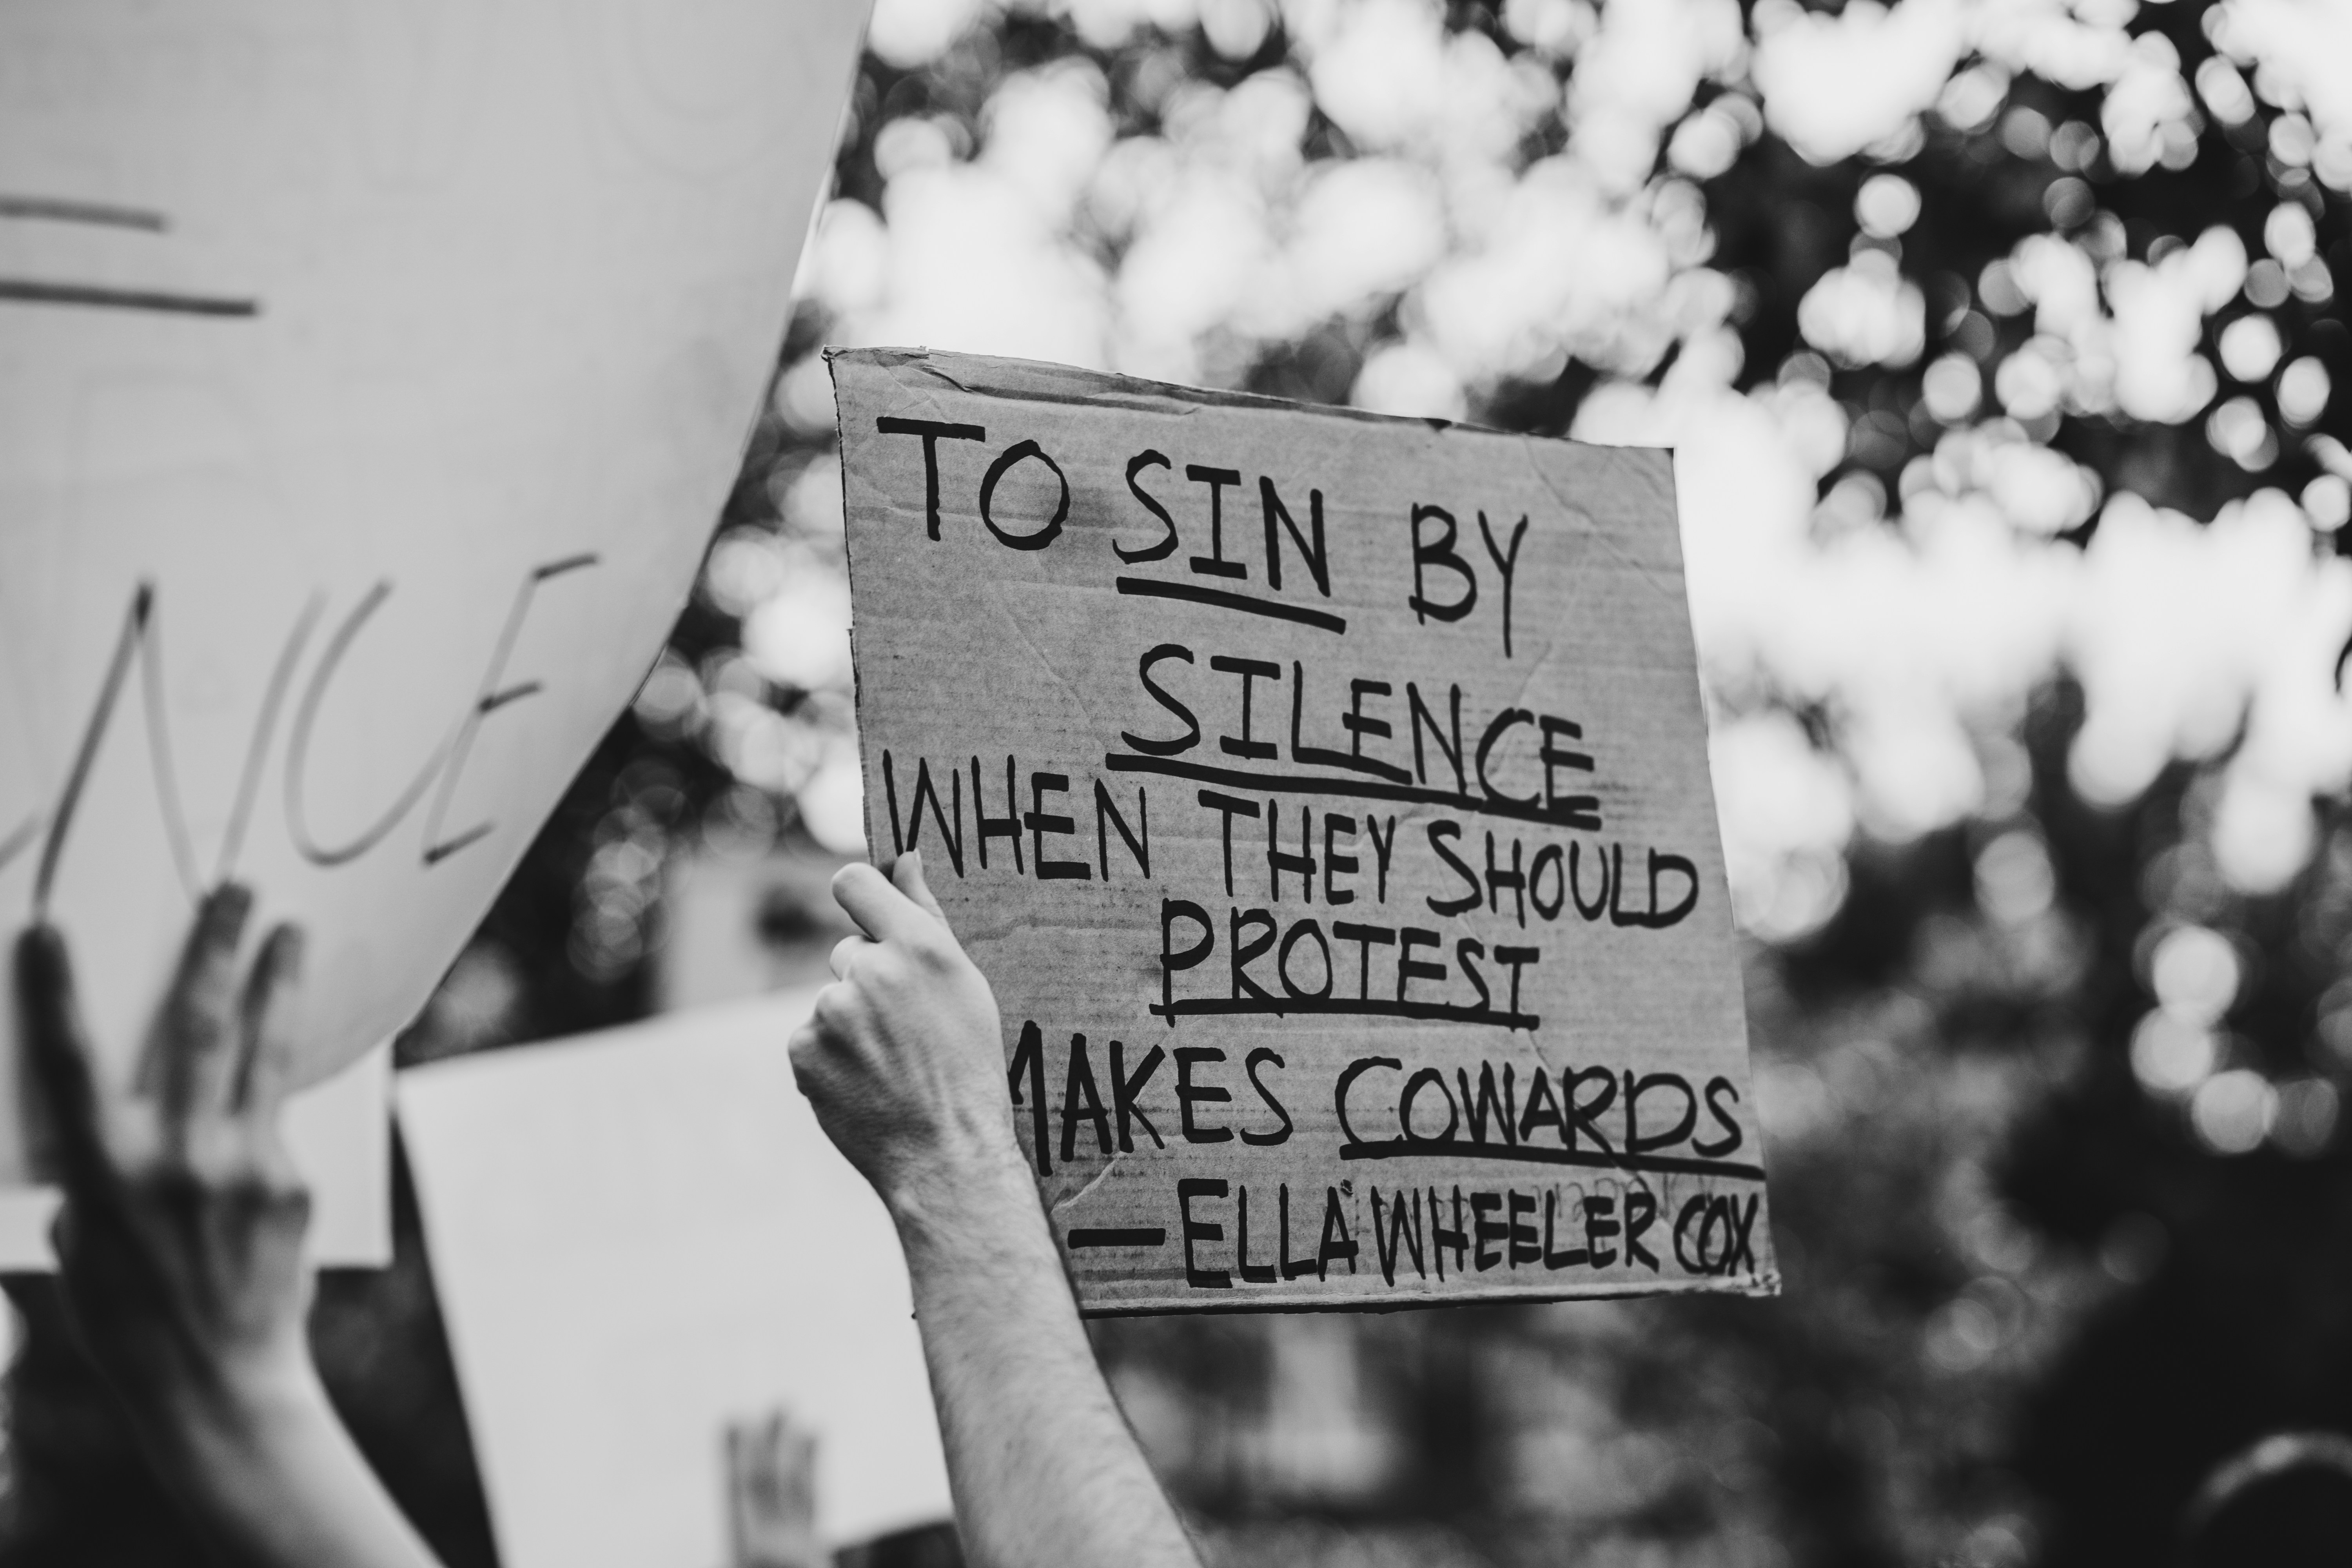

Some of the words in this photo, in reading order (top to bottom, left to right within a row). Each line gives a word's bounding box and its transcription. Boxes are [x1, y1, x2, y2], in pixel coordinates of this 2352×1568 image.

[876, 416, 1071, 551] TO
[1112, 449, 1331, 598] SIN
[1408, 503, 1528, 658] BY
[1120, 643, 1602, 825] SILENCE
[882, 749, 1151, 882] WHEN
[1197, 789, 1396, 906] THEY
[1426, 820, 1699, 929] SHOULD
[1152, 897, 1540, 1032] PROTEST
[1335, 1055, 1743, 1168] COWARDS
[1177, 1178, 1359, 1289] ELLA
[1370, 1184, 1660, 1288] WHEELER
[1673, 1192, 1759, 1287] COX
